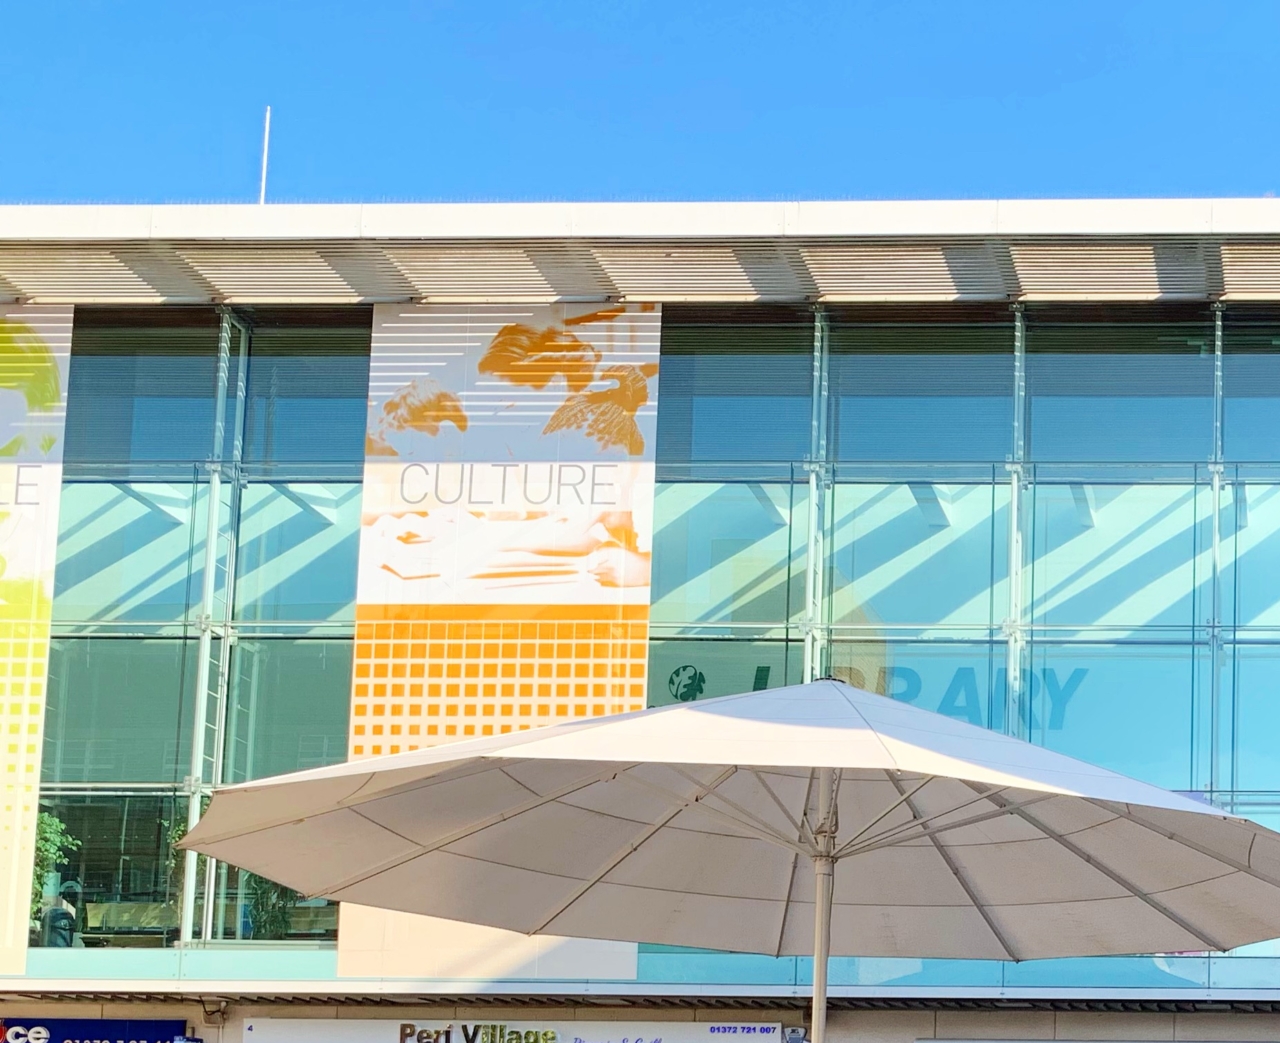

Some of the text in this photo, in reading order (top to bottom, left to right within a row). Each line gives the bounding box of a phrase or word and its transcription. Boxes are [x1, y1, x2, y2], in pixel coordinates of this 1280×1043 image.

[0, 465, 42, 505] E
[400, 463, 618, 505] CULTURE
[710, 1026, 738, 1034] 01372
